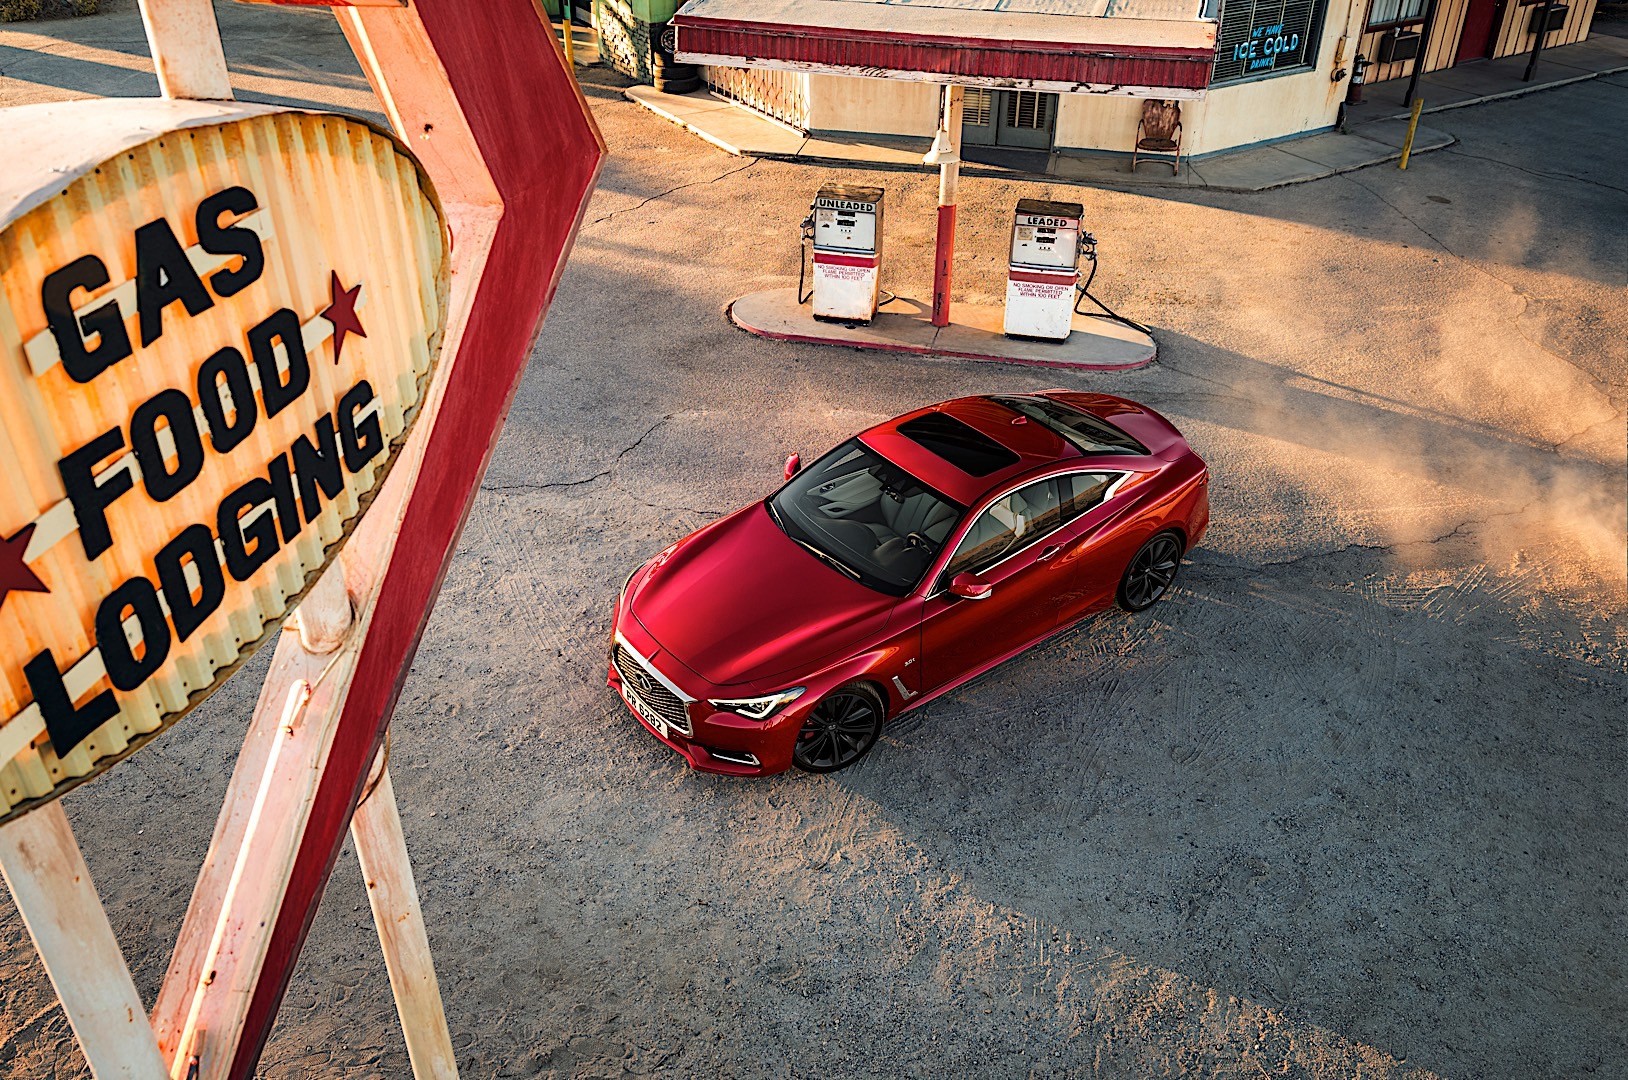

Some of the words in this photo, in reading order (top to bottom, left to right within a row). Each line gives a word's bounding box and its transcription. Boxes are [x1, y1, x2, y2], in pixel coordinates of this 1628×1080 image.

[1233, 41, 1258, 61] ICE
[1263, 34, 1299, 55] COLD
[1249, 57, 1274, 70] DRINKS
[819, 199, 873, 211] UNLEADED
[1027, 216, 1067, 227] LEADED
[41, 186, 265, 384] GAS
[58, 307, 310, 561] FOOD
[23, 380, 384, 760] LODGING
